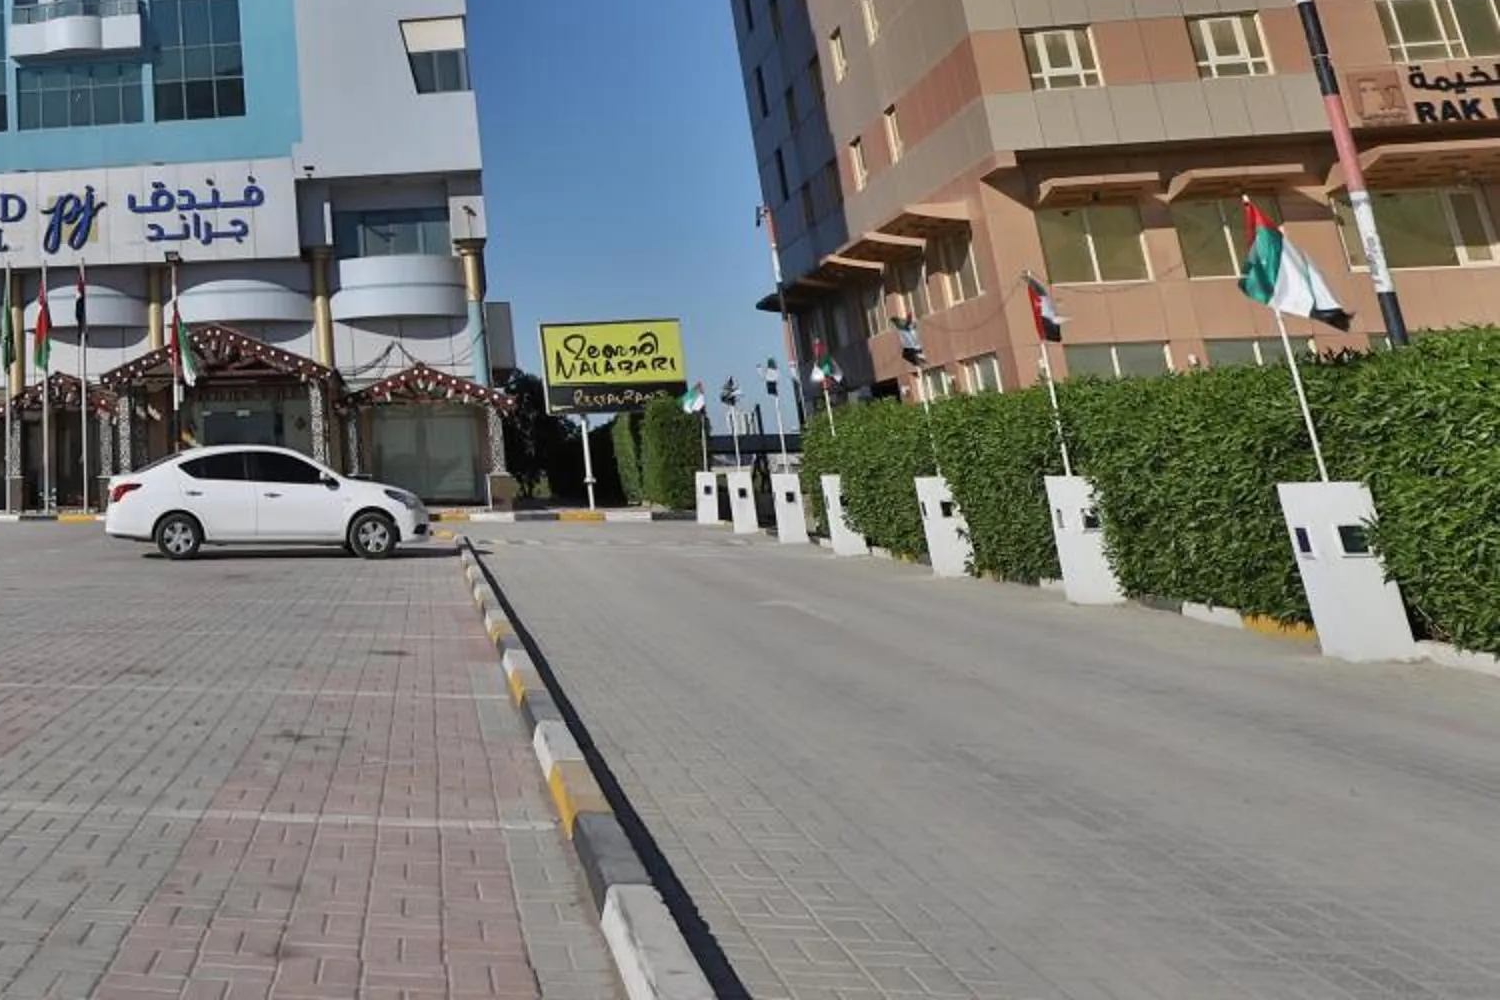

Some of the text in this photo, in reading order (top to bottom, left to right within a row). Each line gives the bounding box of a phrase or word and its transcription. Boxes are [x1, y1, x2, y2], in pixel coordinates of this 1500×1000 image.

[1414, 98, 1487, 123] RAK
[127, 175, 265, 213] فندق
[146, 212, 249, 246] جراند
[556, 350, 677, 380] MALABARI
